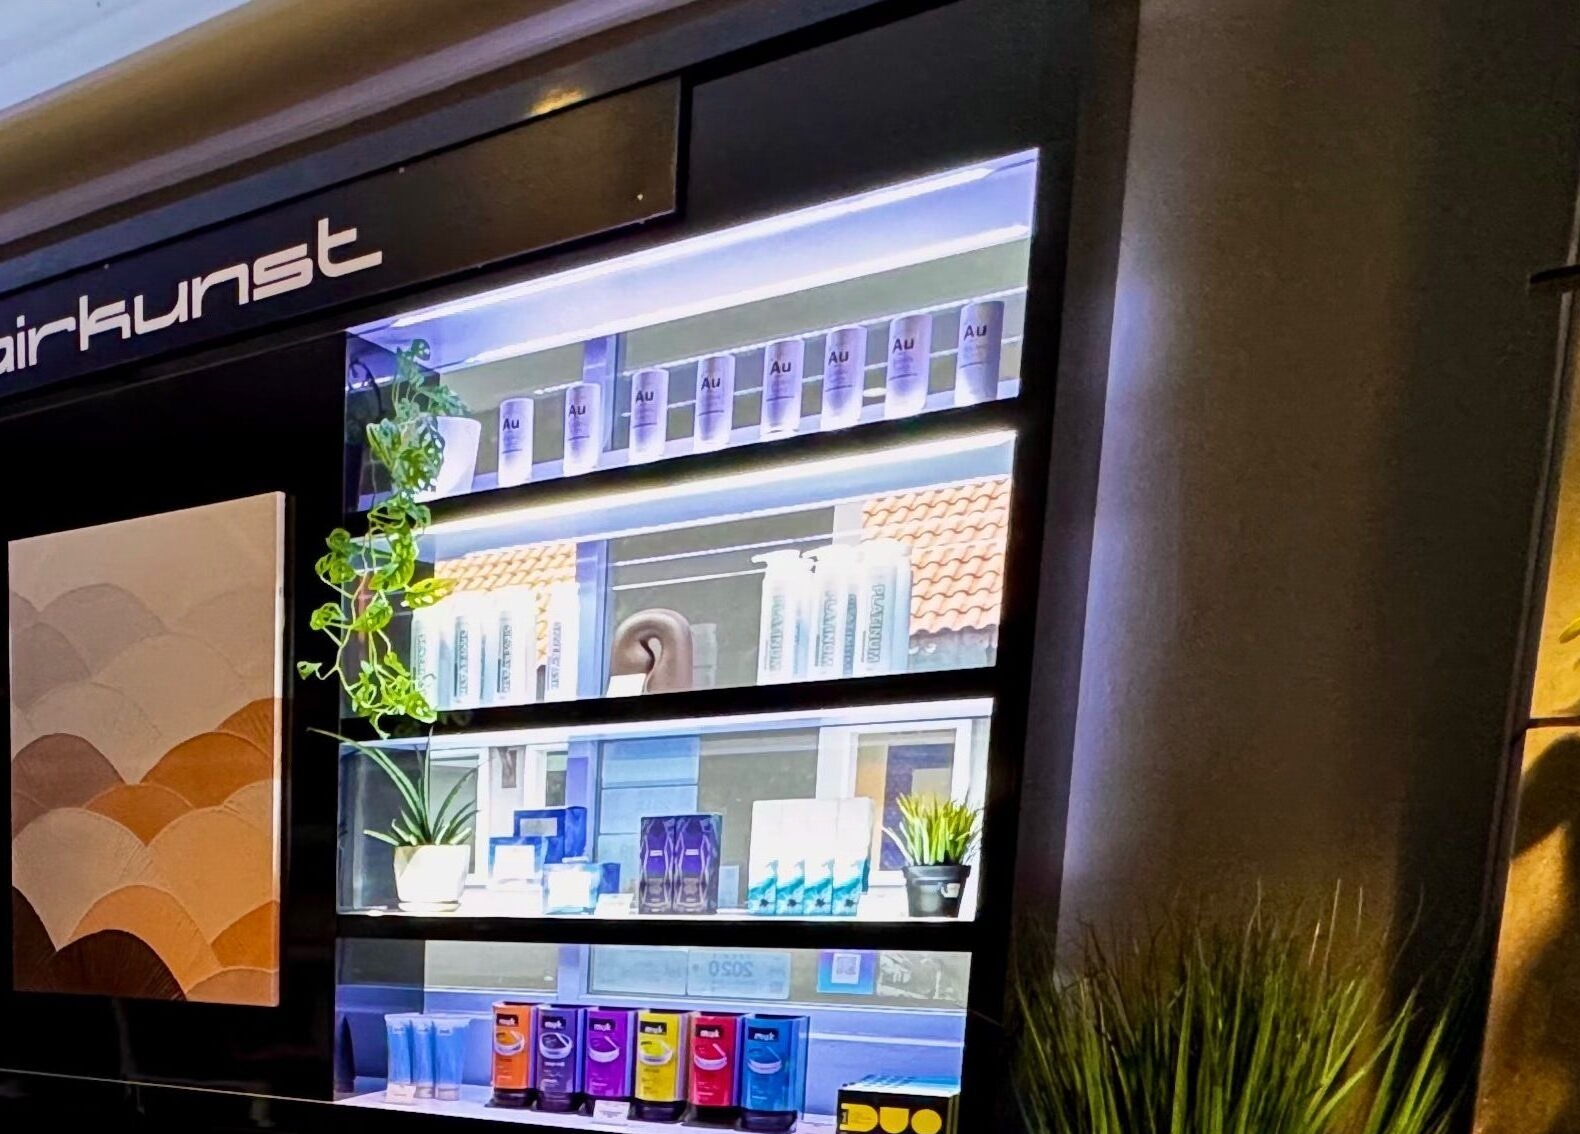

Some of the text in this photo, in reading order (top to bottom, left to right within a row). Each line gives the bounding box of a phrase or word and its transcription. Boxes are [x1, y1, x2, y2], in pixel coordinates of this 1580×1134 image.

[963, 323, 988, 339] Au
[892, 337, 915, 353] Au
[827, 350, 850, 364] Au
[769, 360, 792, 375] Au
[700, 376, 721, 390] Au
[635, 390, 655, 402] Au
[568, 404, 586, 418] Au
[502, 418, 520, 430] Au
[866, 583, 885, 664] PLATINUM
